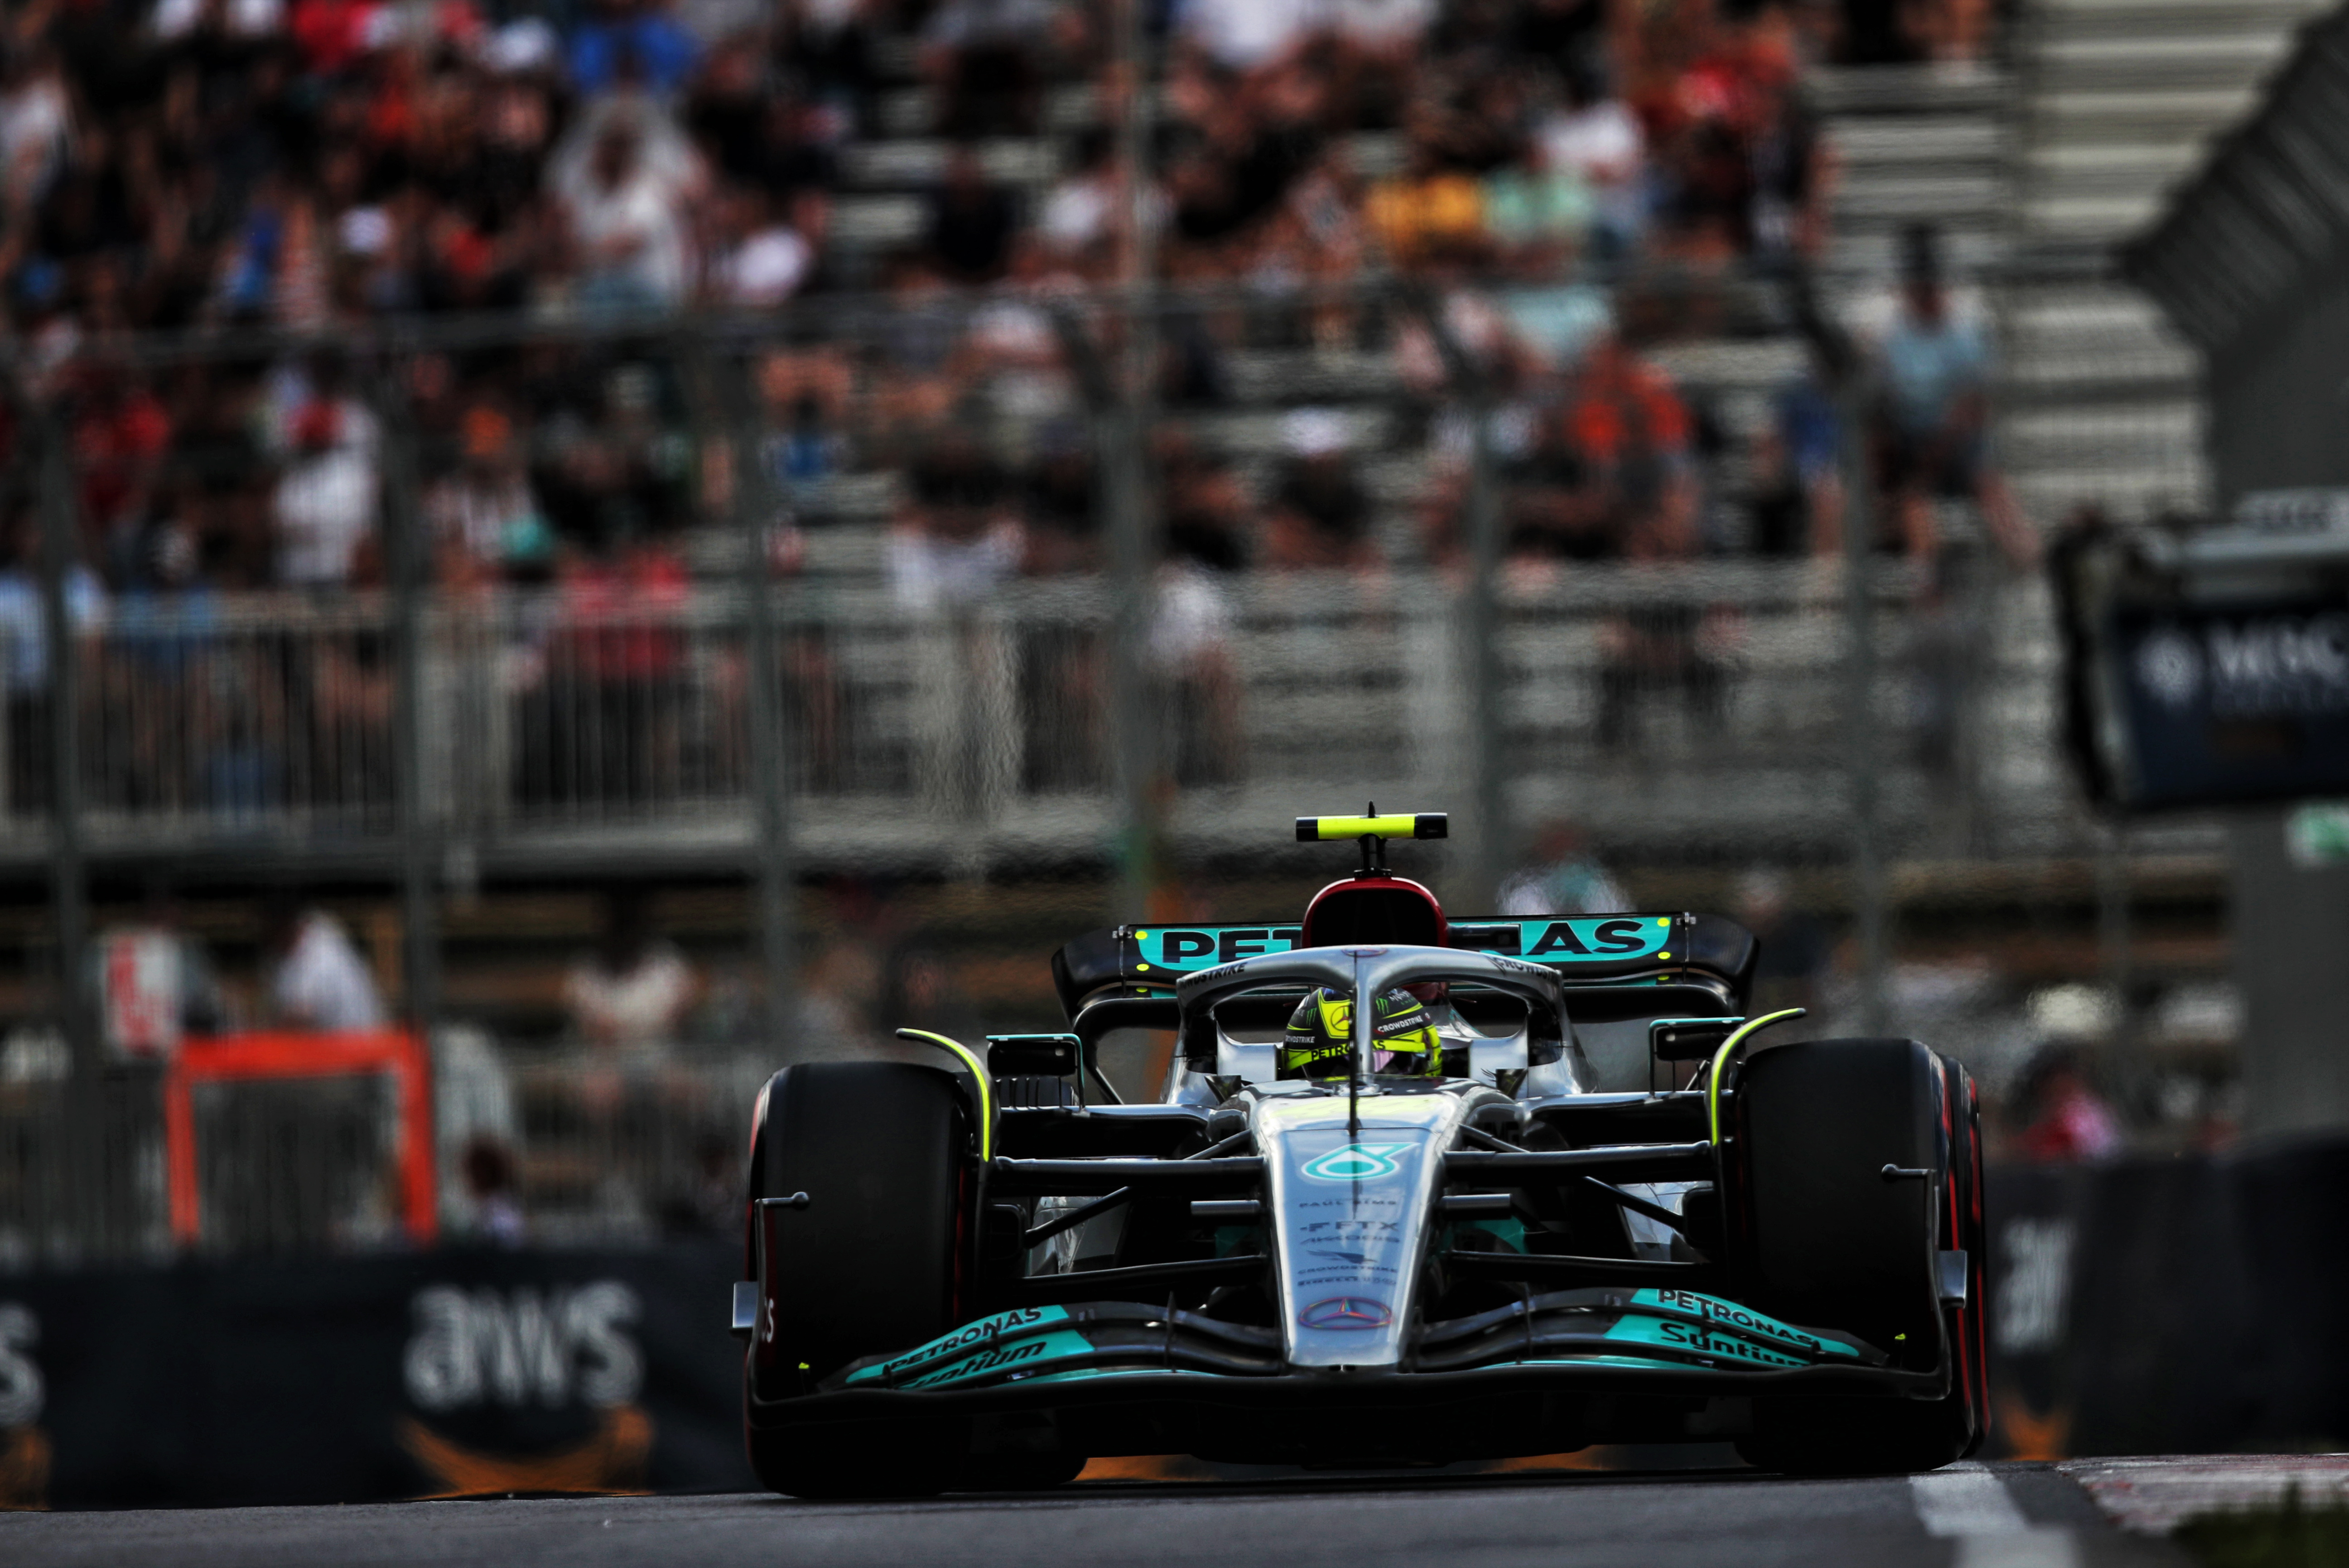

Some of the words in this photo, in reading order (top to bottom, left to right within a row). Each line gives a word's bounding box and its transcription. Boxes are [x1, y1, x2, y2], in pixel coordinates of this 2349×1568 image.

[1378, 1015, 1424, 1032] CROWDSTRIKE
[1335, 1221, 1399, 1231] FTX
[1658, 1289, 1813, 1345] PETRONAS
[891, 1307, 1042, 1370] PETRONAS
